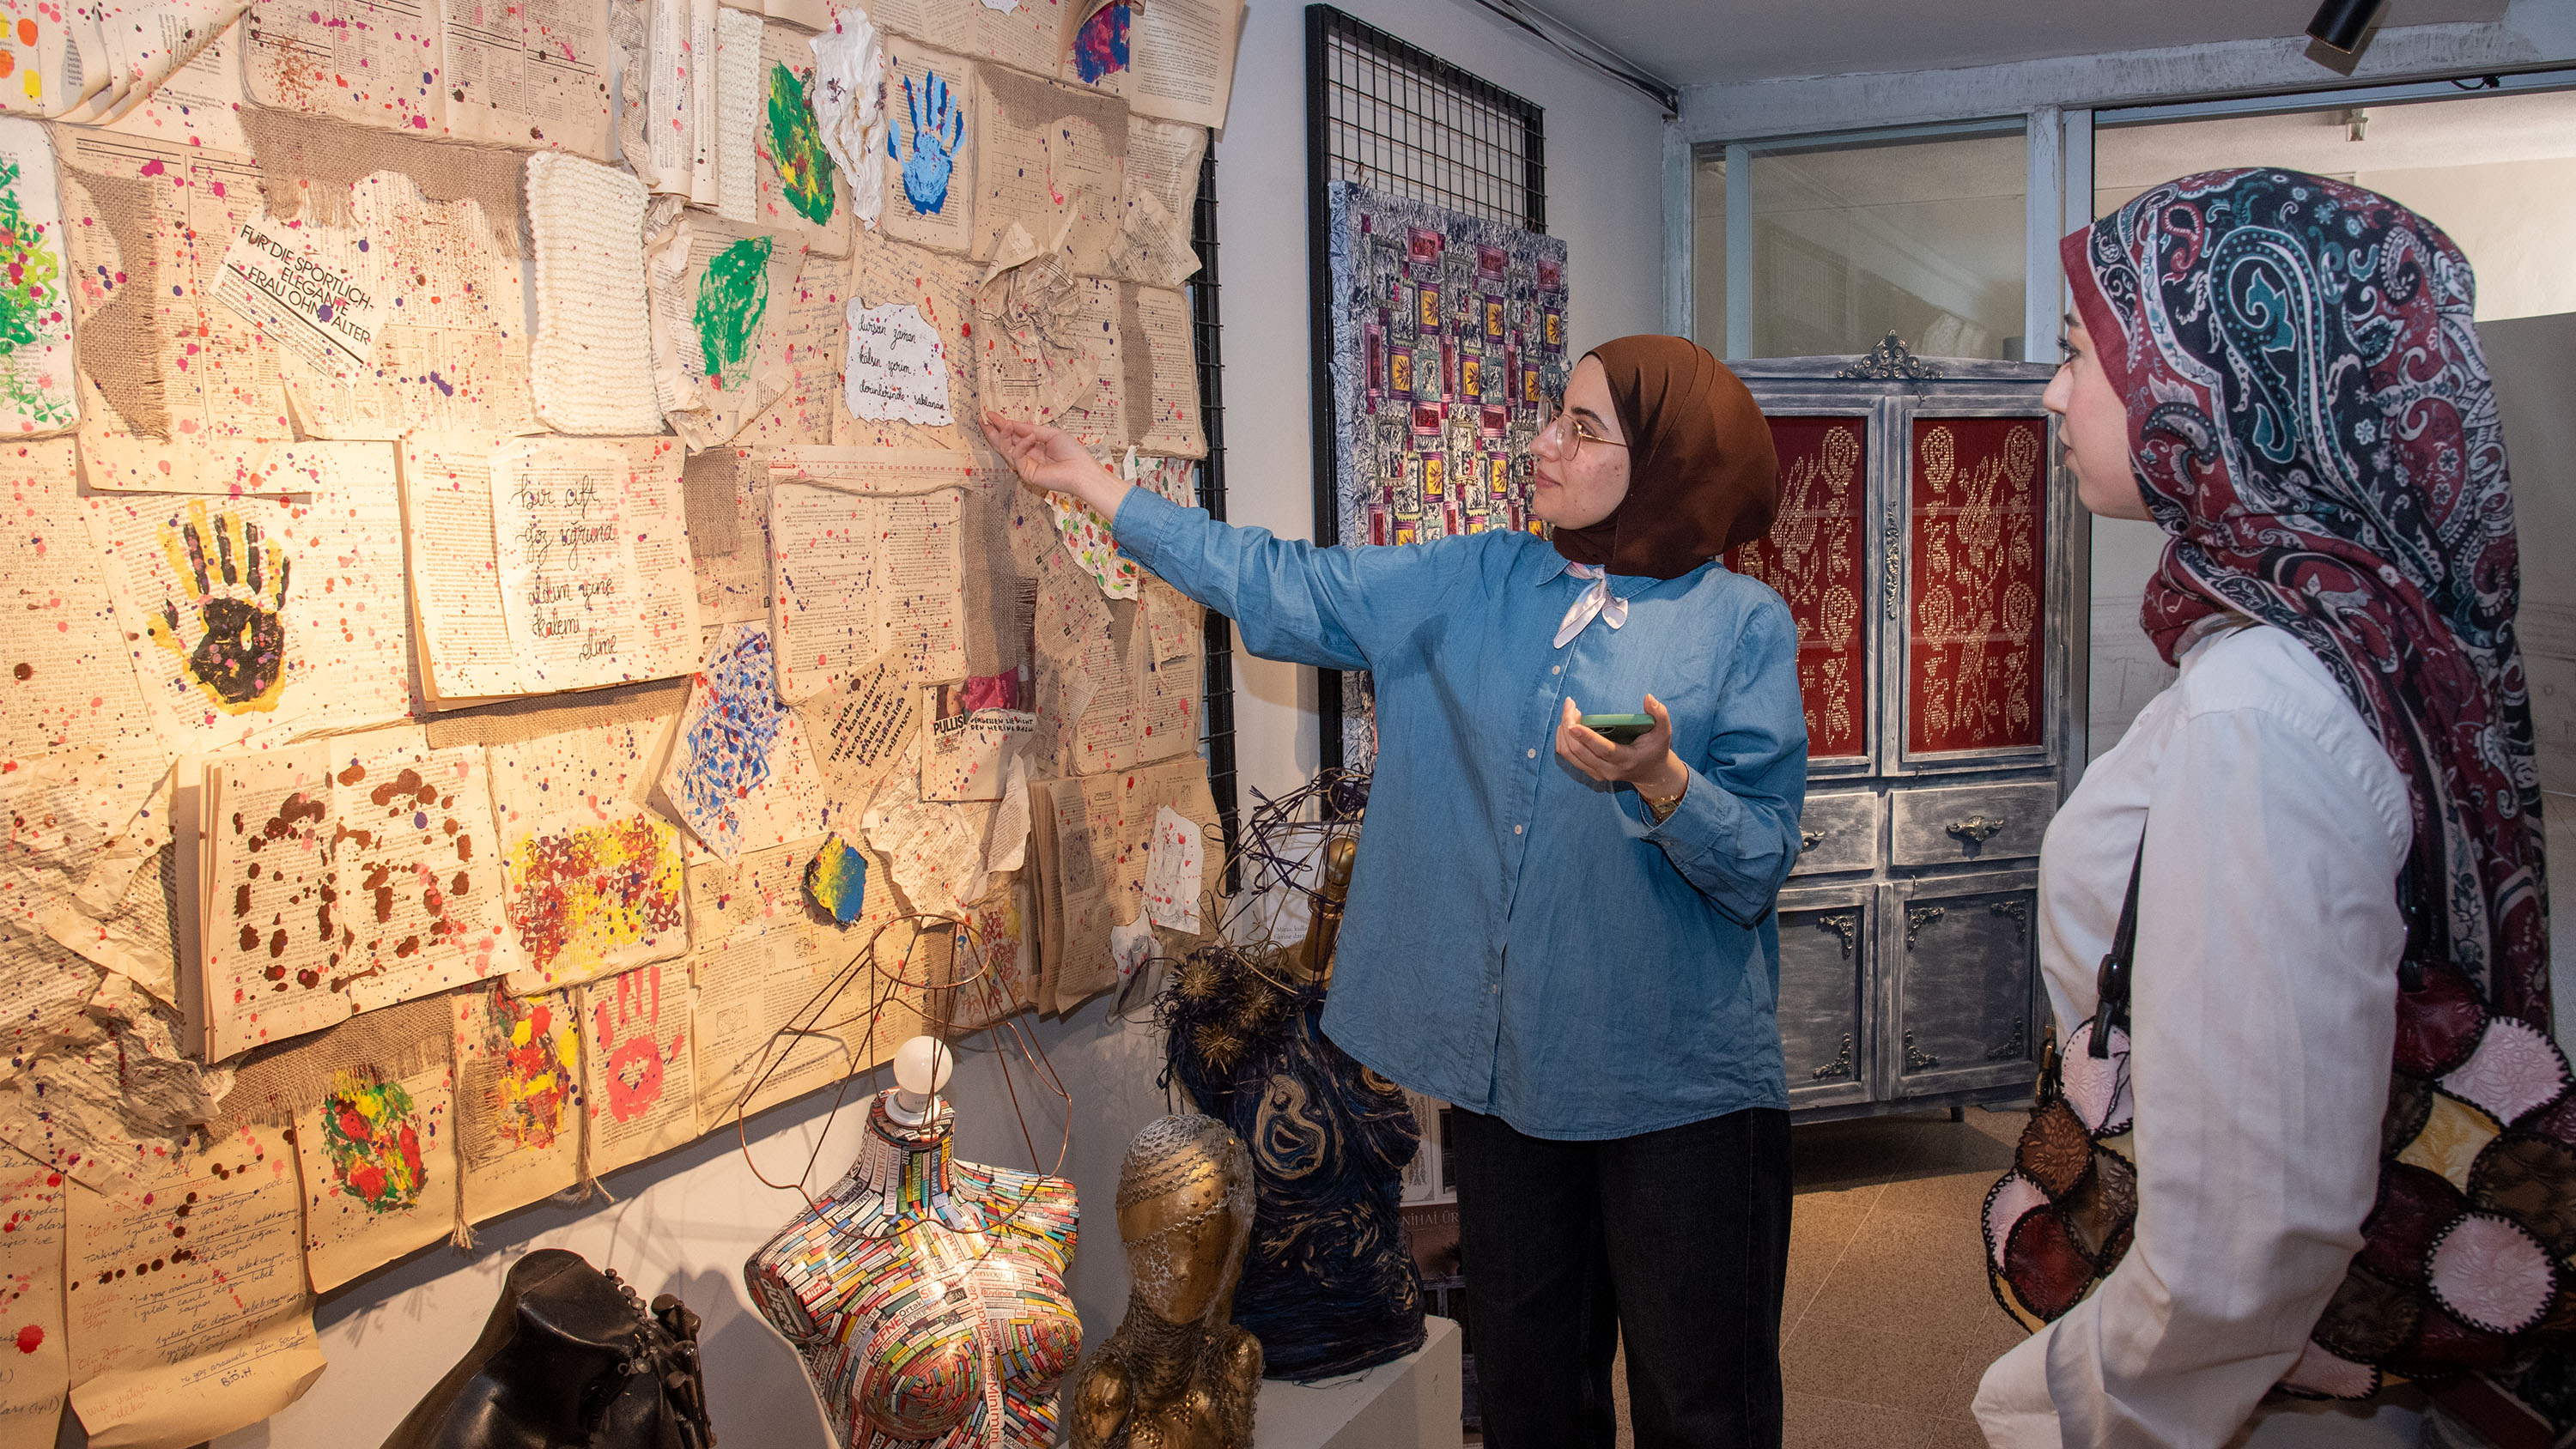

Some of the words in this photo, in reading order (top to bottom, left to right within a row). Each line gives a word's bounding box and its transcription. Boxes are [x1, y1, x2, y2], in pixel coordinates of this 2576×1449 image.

[240, 224, 270, 252] FÜR
[270, 242, 295, 266] DIE
[294, 257, 374, 310] SPORTLICH-
[281, 267, 351, 317] ELEGANTE
[248, 266, 286, 297] FRAU
[288, 290, 333, 323] OHN
[331, 316, 371, 346] ALTER
[890, 329, 916, 350] zaman
[829, 735, 847, 762] Türk
[1010, 1227, 1030, 1238] Koku
[803, 1279, 830, 1303] Müzik
[899, 1300, 923, 1317] Ortak
[866, 1314, 903, 1356] DEFNE
